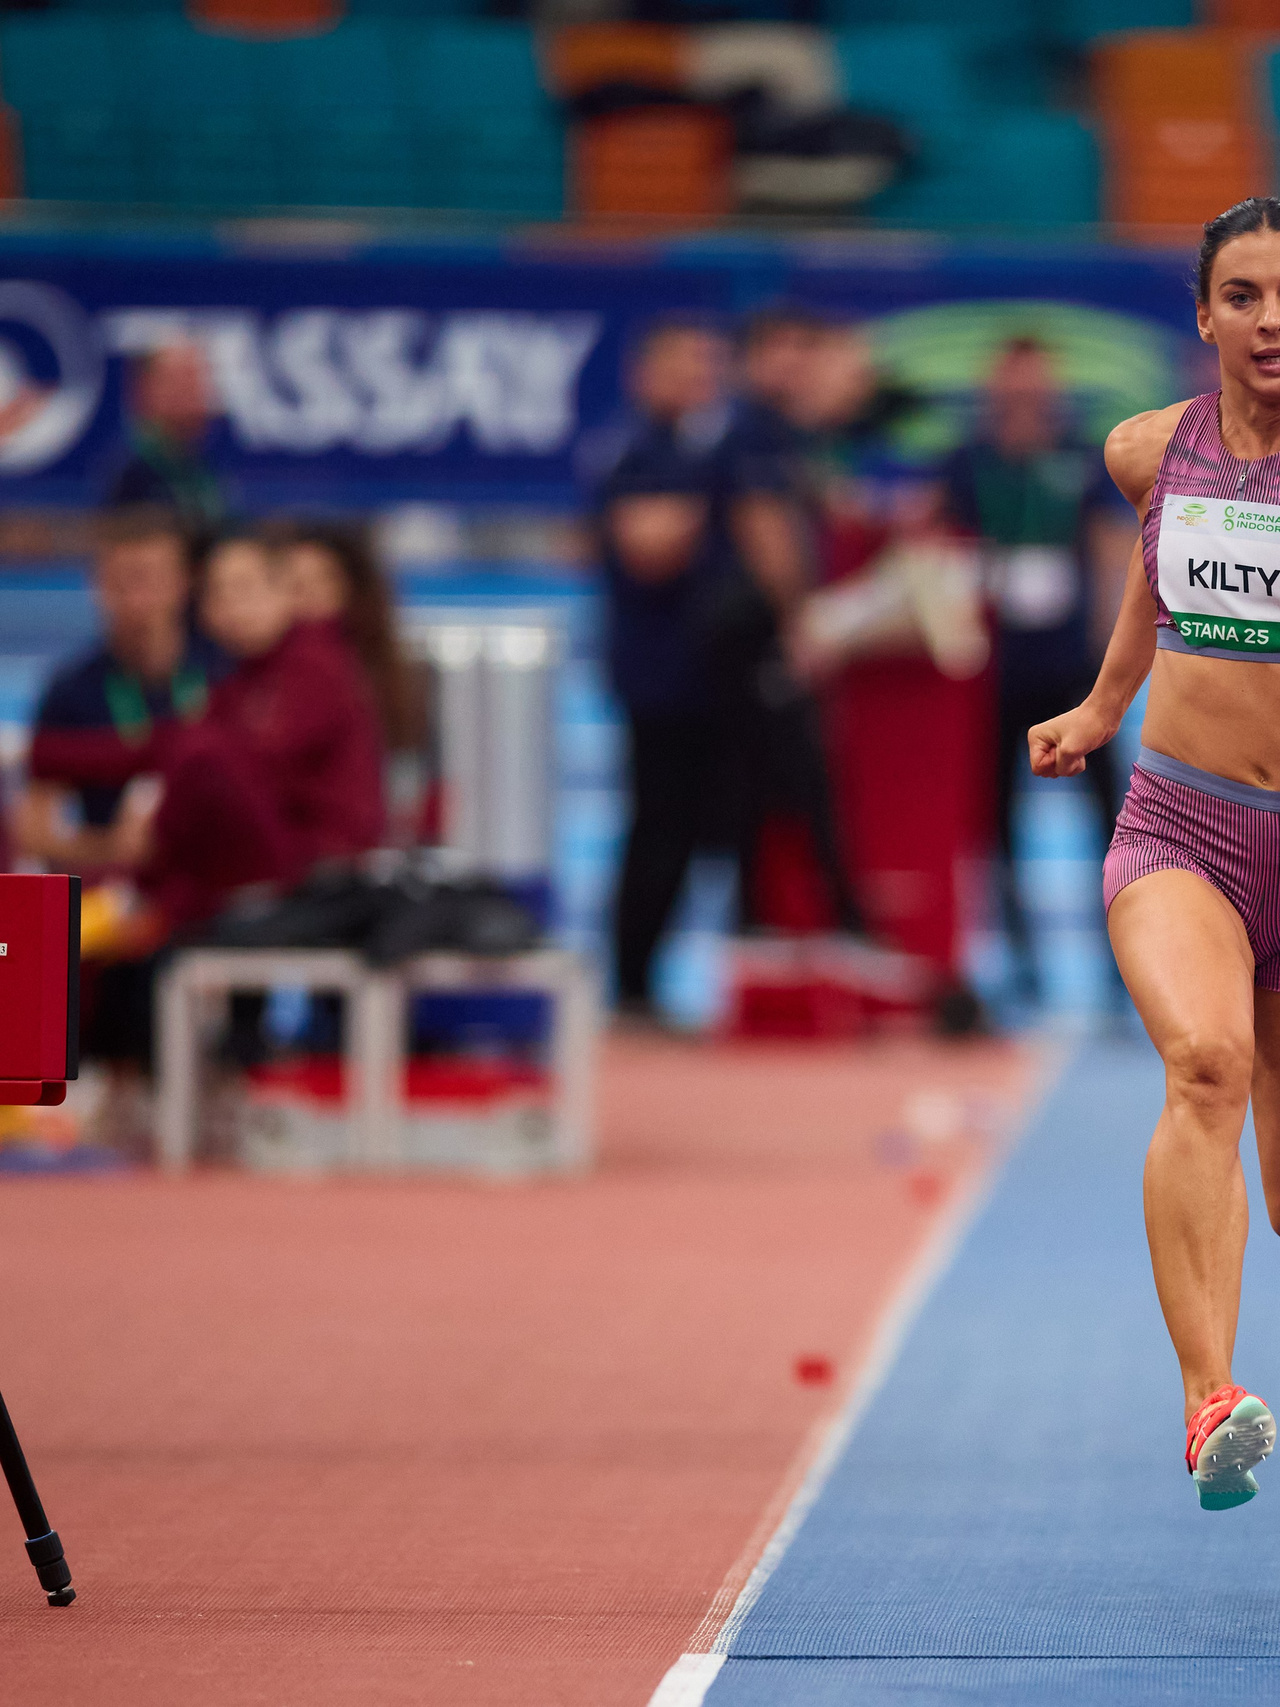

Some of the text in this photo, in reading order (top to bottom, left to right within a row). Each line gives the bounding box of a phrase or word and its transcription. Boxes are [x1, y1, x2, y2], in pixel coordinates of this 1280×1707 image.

[1188, 558, 1280, 597] KILTY
[1180, 621, 1270, 645] STANA 25
